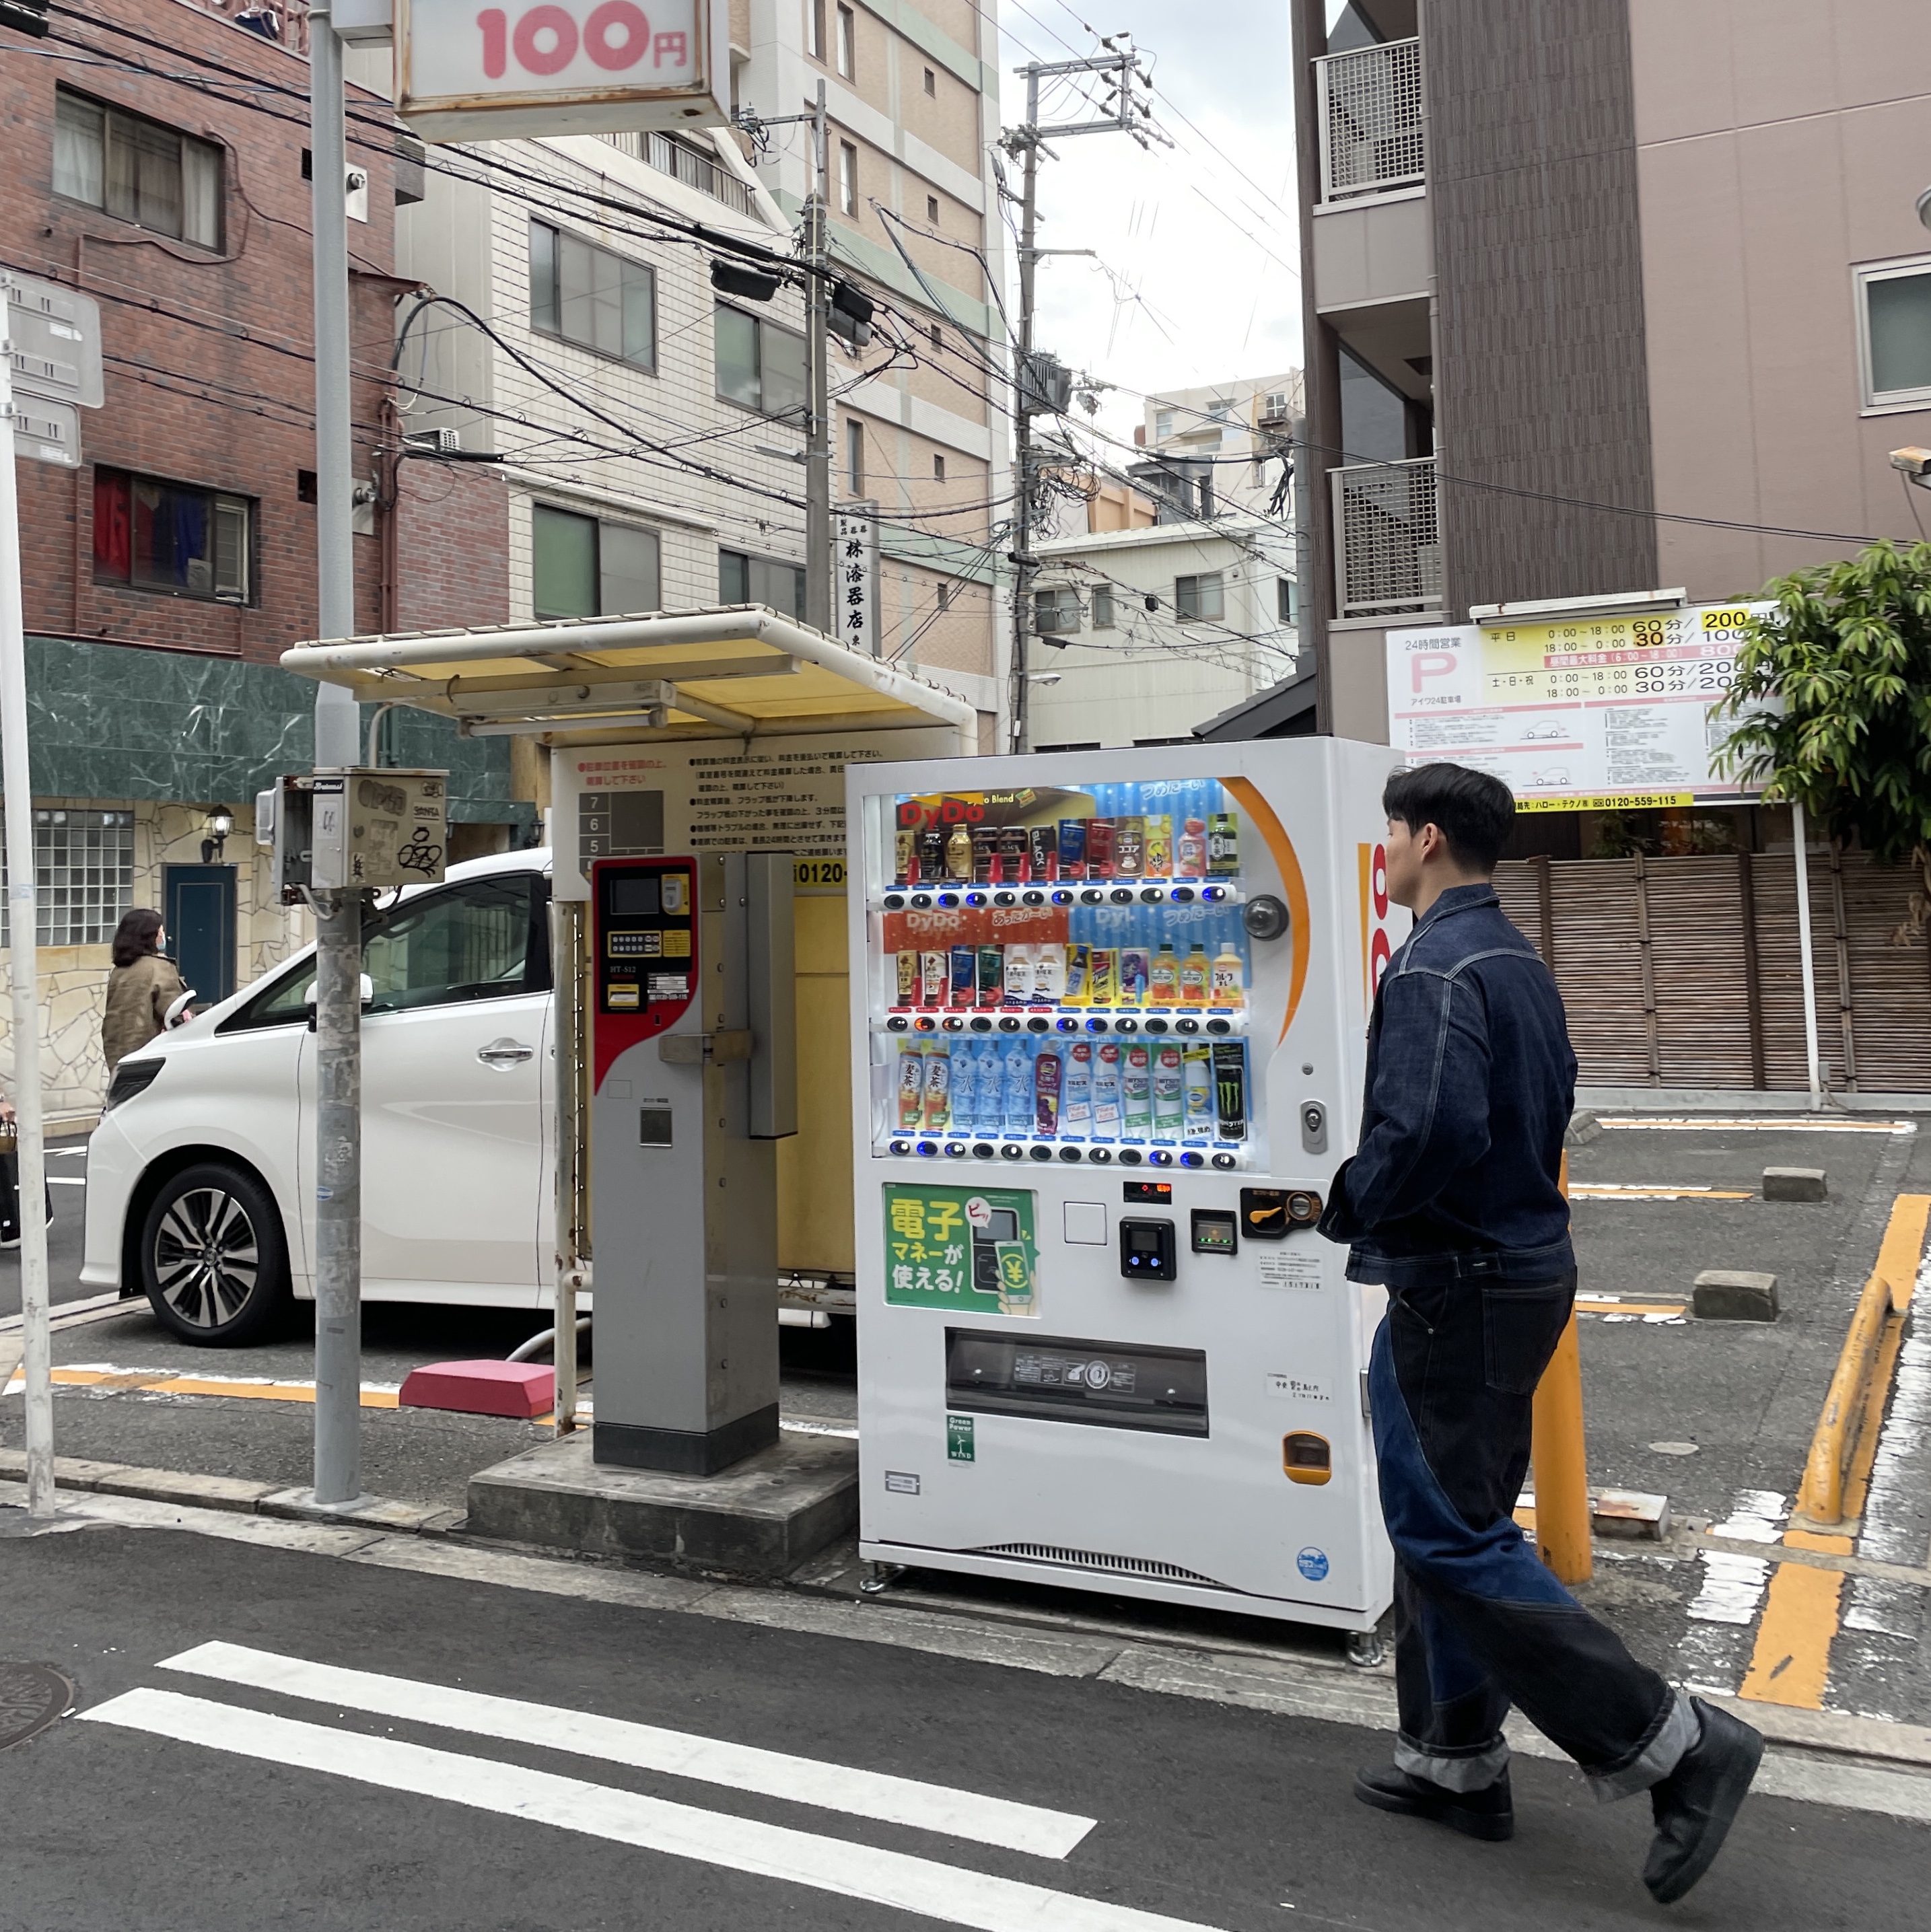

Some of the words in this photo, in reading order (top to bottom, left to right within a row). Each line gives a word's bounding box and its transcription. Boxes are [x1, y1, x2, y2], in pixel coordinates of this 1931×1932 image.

[477, 0, 687, 79] 100円
[845, 538, 865, 630] 林漆器店
[1405, 637, 1461, 651] 24時間営業
[1491, 631, 1516, 643] 平日
[1411, 651, 1457, 694] P
[590, 796, 599, 809] 7
[991, 793, 1014, 803] Blend
[1605, 795, 1677, 808] 0120-559-115
[590, 818, 599, 831] 6
[901, 801, 985, 830] DyDo
[590, 840, 599, 853] 5
[1032, 830, 1045, 867] BLACK
[1119, 845, 1140, 854] ココア
[903, 1063, 915, 1087] 麦茶
[929, 1064, 942, 1087] 麦茶
[960, 1075, 974, 1093] 水
[1016, 1074, 1028, 1093] 水
[987, 1075, 999, 1094] 水
[890, 1198, 963, 1242] 電子
[891, 1242, 964, 1265] マネーが
[892, 1264, 964, 1294] 使える!
[948, 1423, 972, 1431] Power
[949, 1417, 971, 1425] Green
[950, 1450, 971, 1459] WIND
